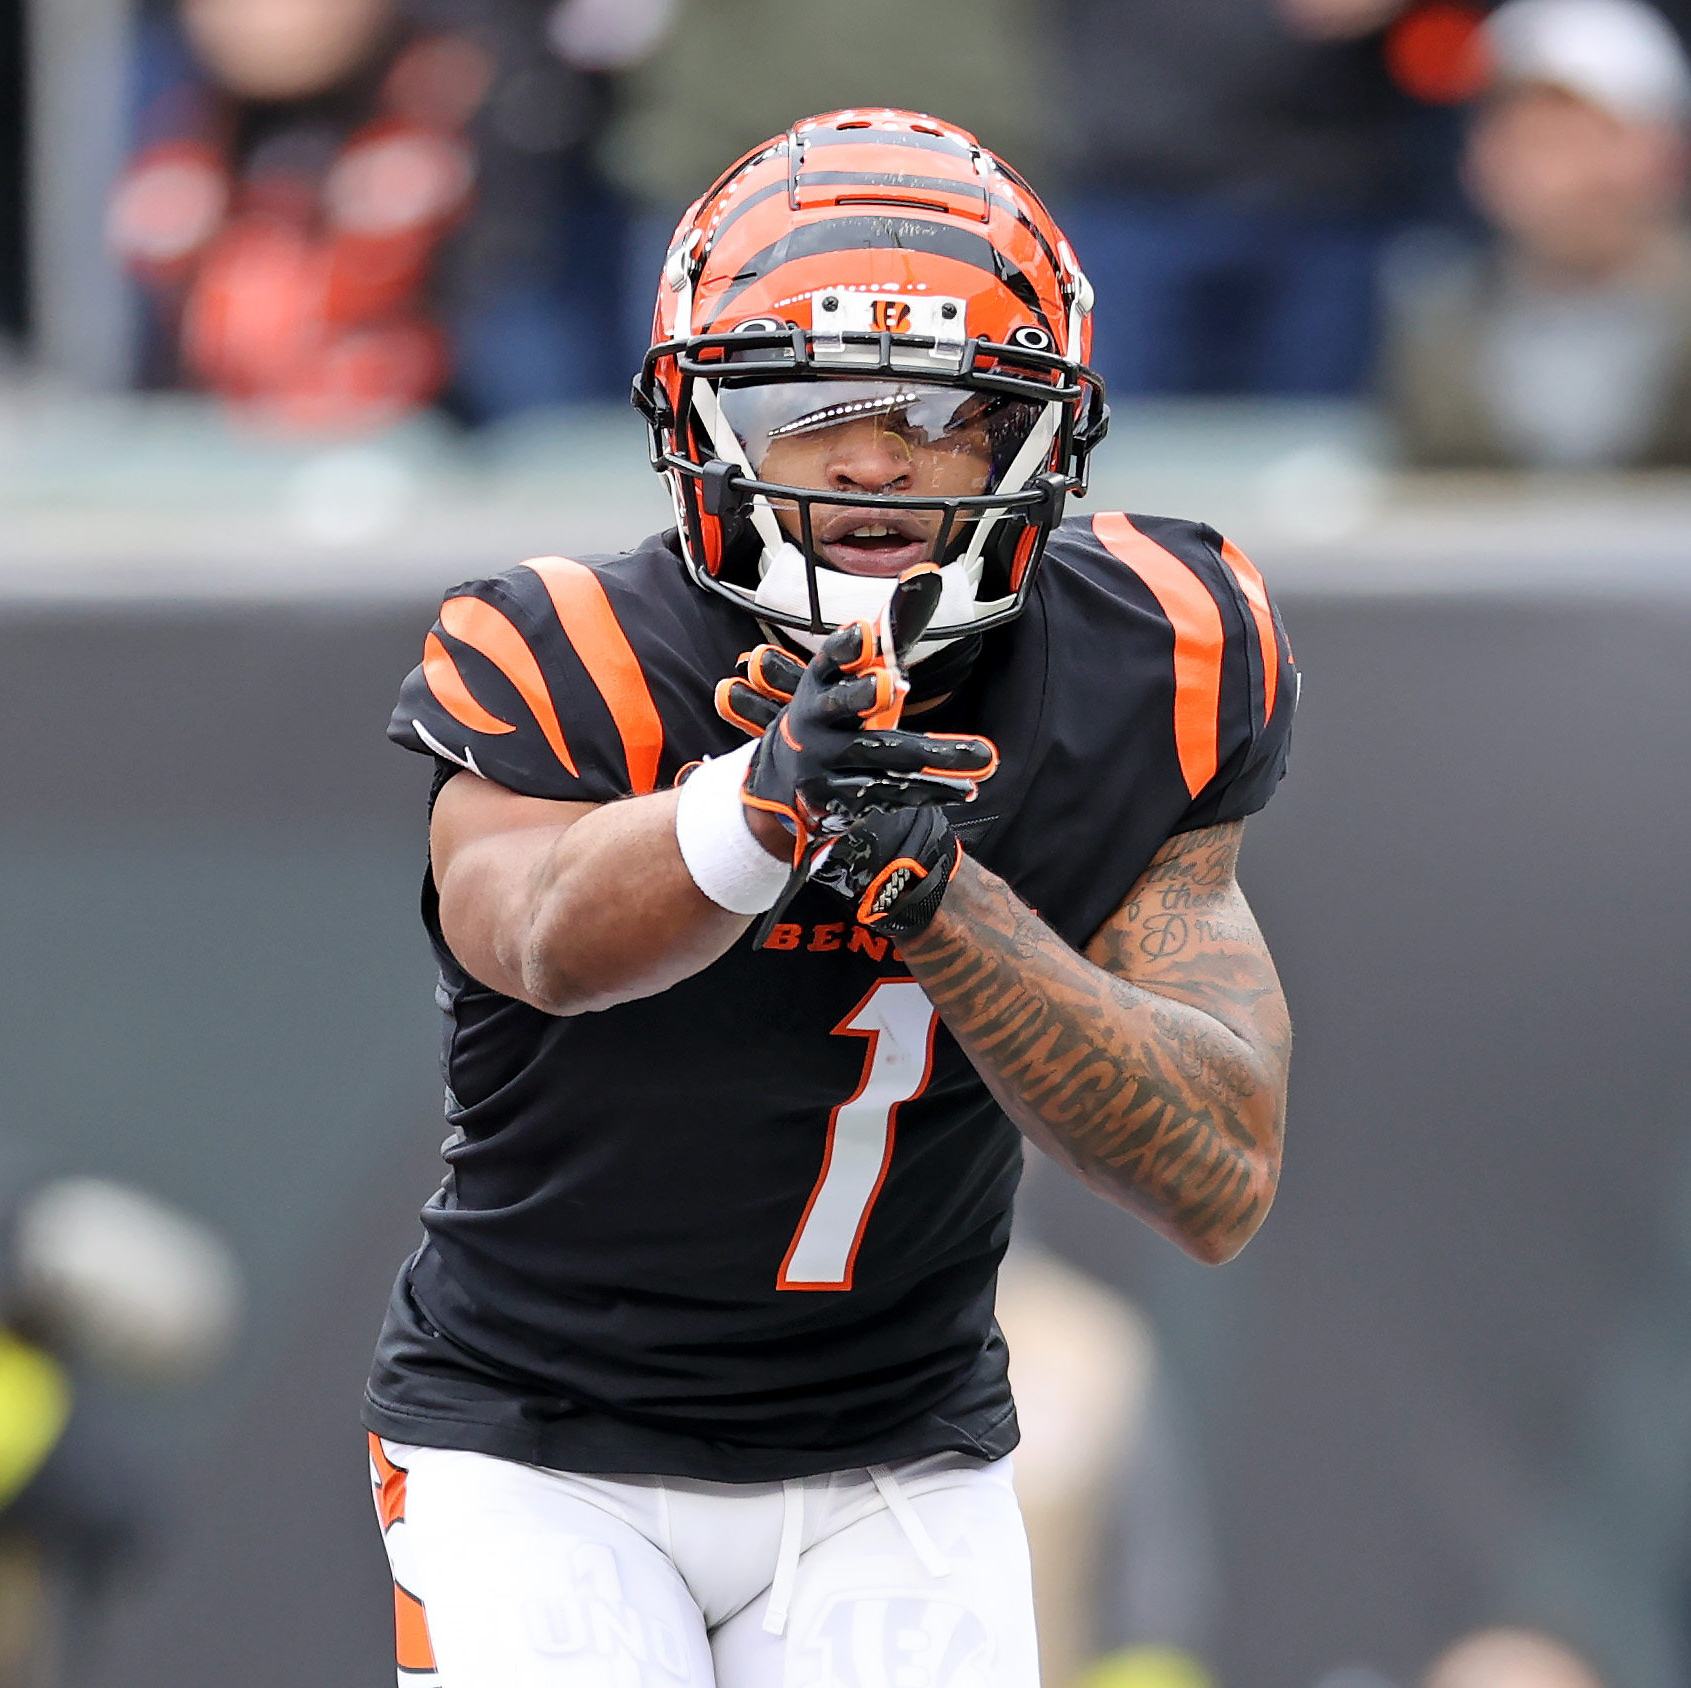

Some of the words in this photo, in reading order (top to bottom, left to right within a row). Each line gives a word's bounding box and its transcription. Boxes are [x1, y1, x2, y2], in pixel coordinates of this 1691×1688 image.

[762, 922, 906, 962] BEN
[775, 976, 940, 1291] 1
[521, 1597, 691, 1682] UNO
